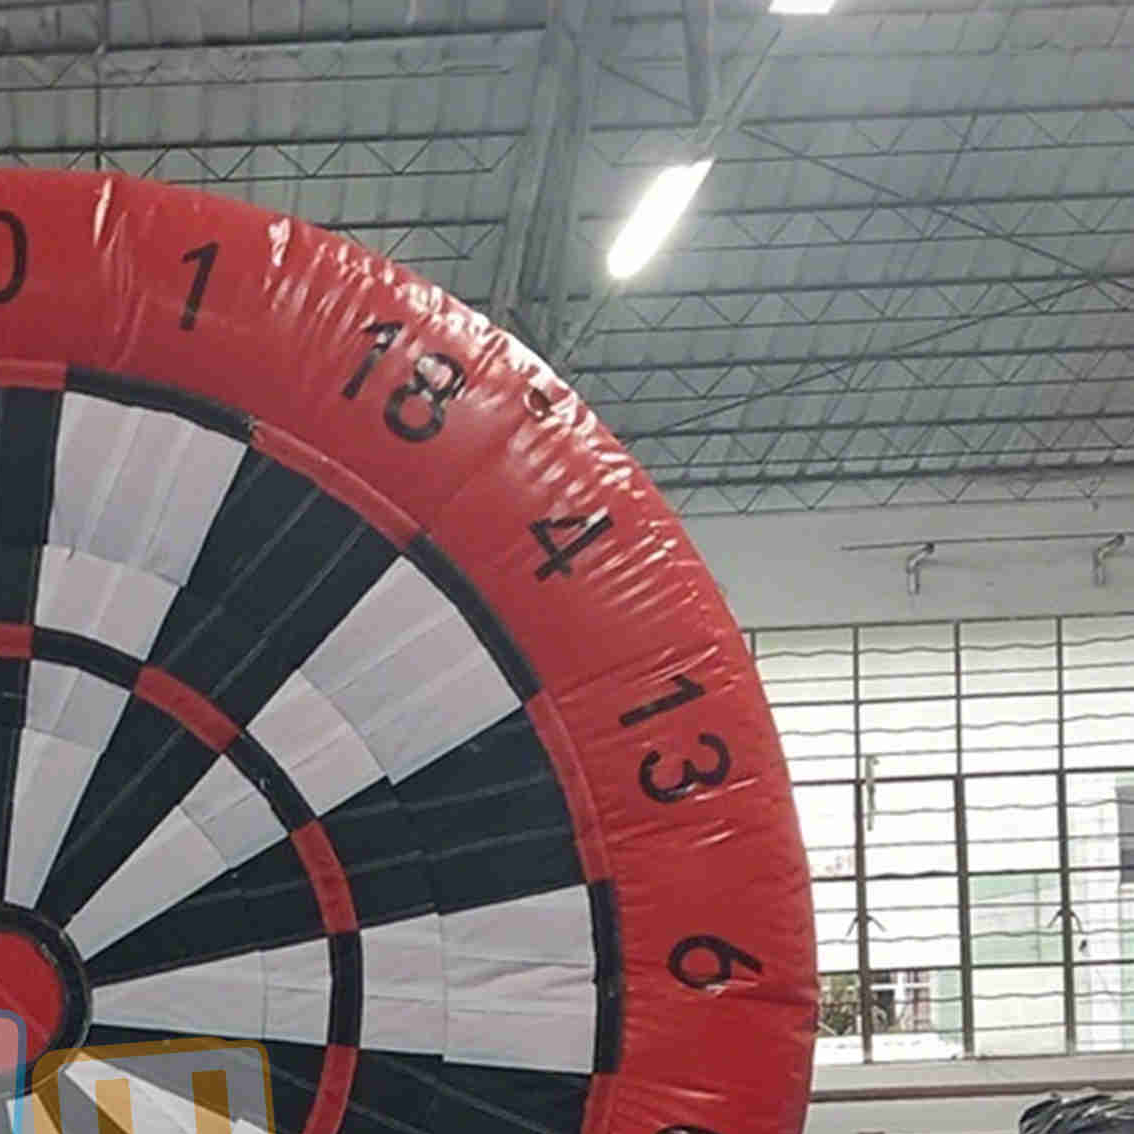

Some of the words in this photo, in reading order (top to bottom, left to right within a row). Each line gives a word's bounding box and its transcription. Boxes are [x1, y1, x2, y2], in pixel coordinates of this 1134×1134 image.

[180, 243, 218, 331] 1
[342, 317, 467, 442] 18
[530, 516, 613, 580] 4
[619, 675, 730, 804] 13
[666, 936, 762, 990] 6
